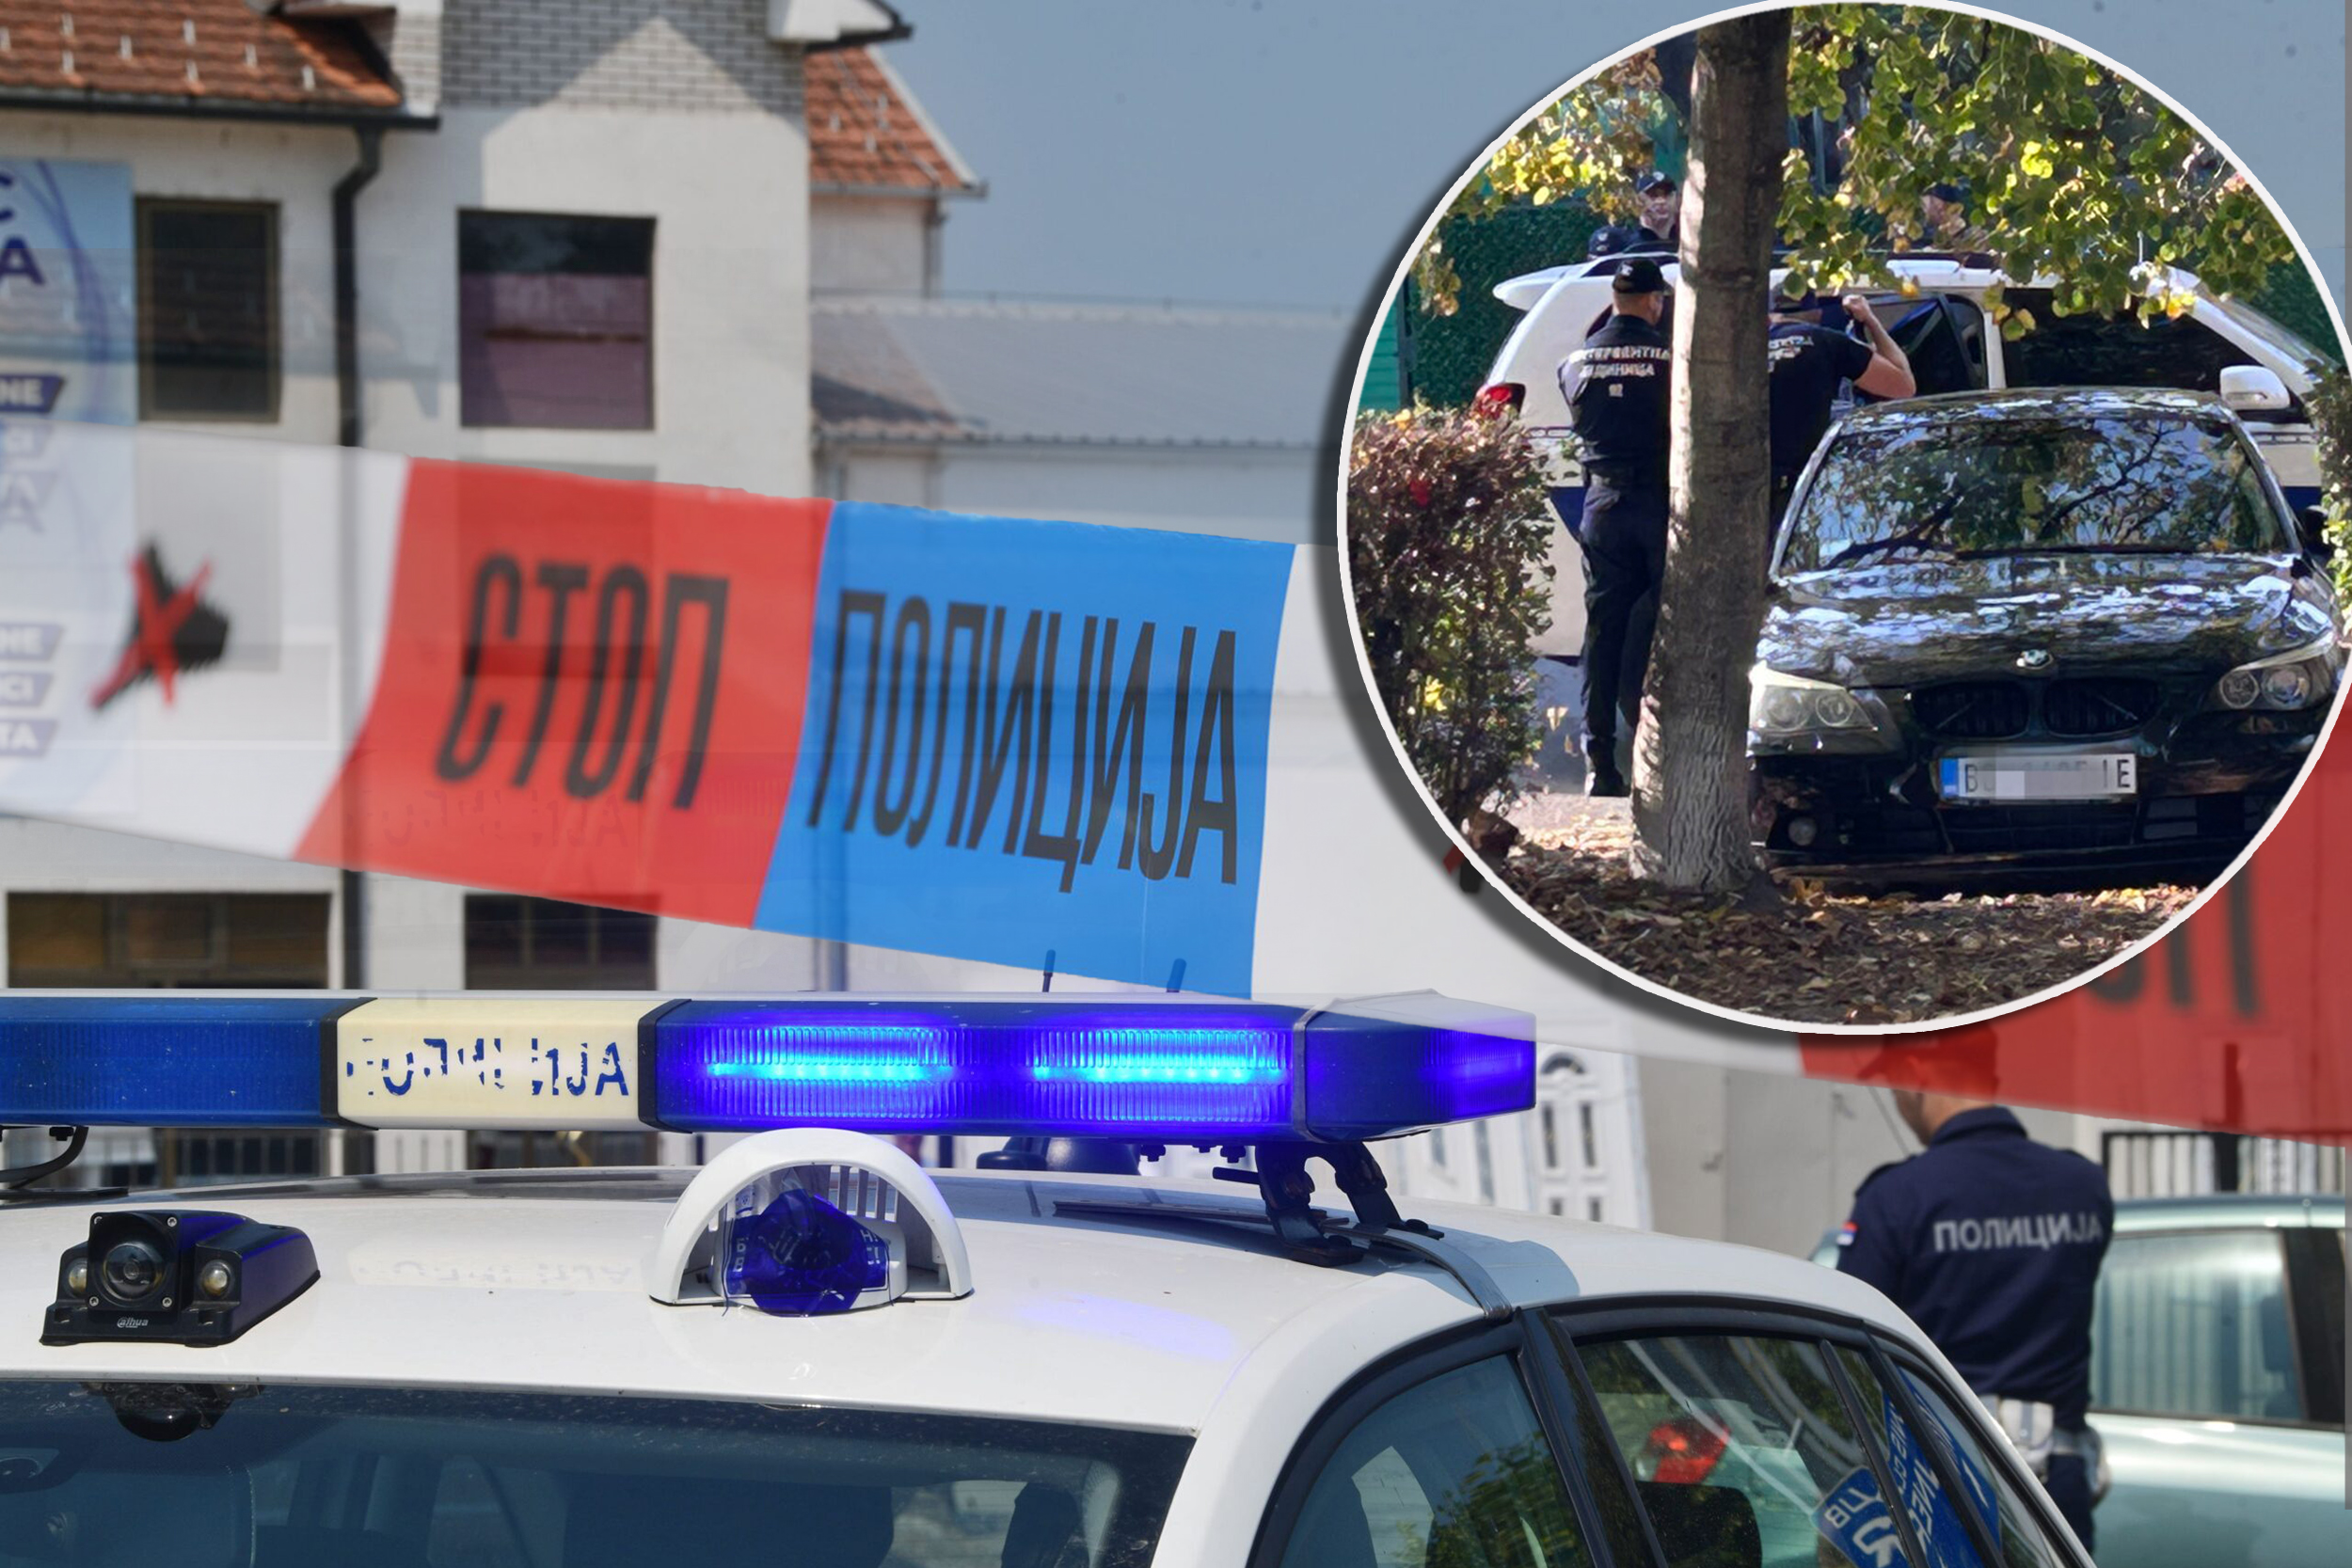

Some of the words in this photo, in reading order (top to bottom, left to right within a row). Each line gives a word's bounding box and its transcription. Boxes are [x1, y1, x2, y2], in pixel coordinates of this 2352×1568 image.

[435, 553, 730, 811] СТОП
[806, 587, 1236, 893] ПОЛИЦИЈА
[1933, 1212, 2102, 1252] ПОЛИЦИЈА
